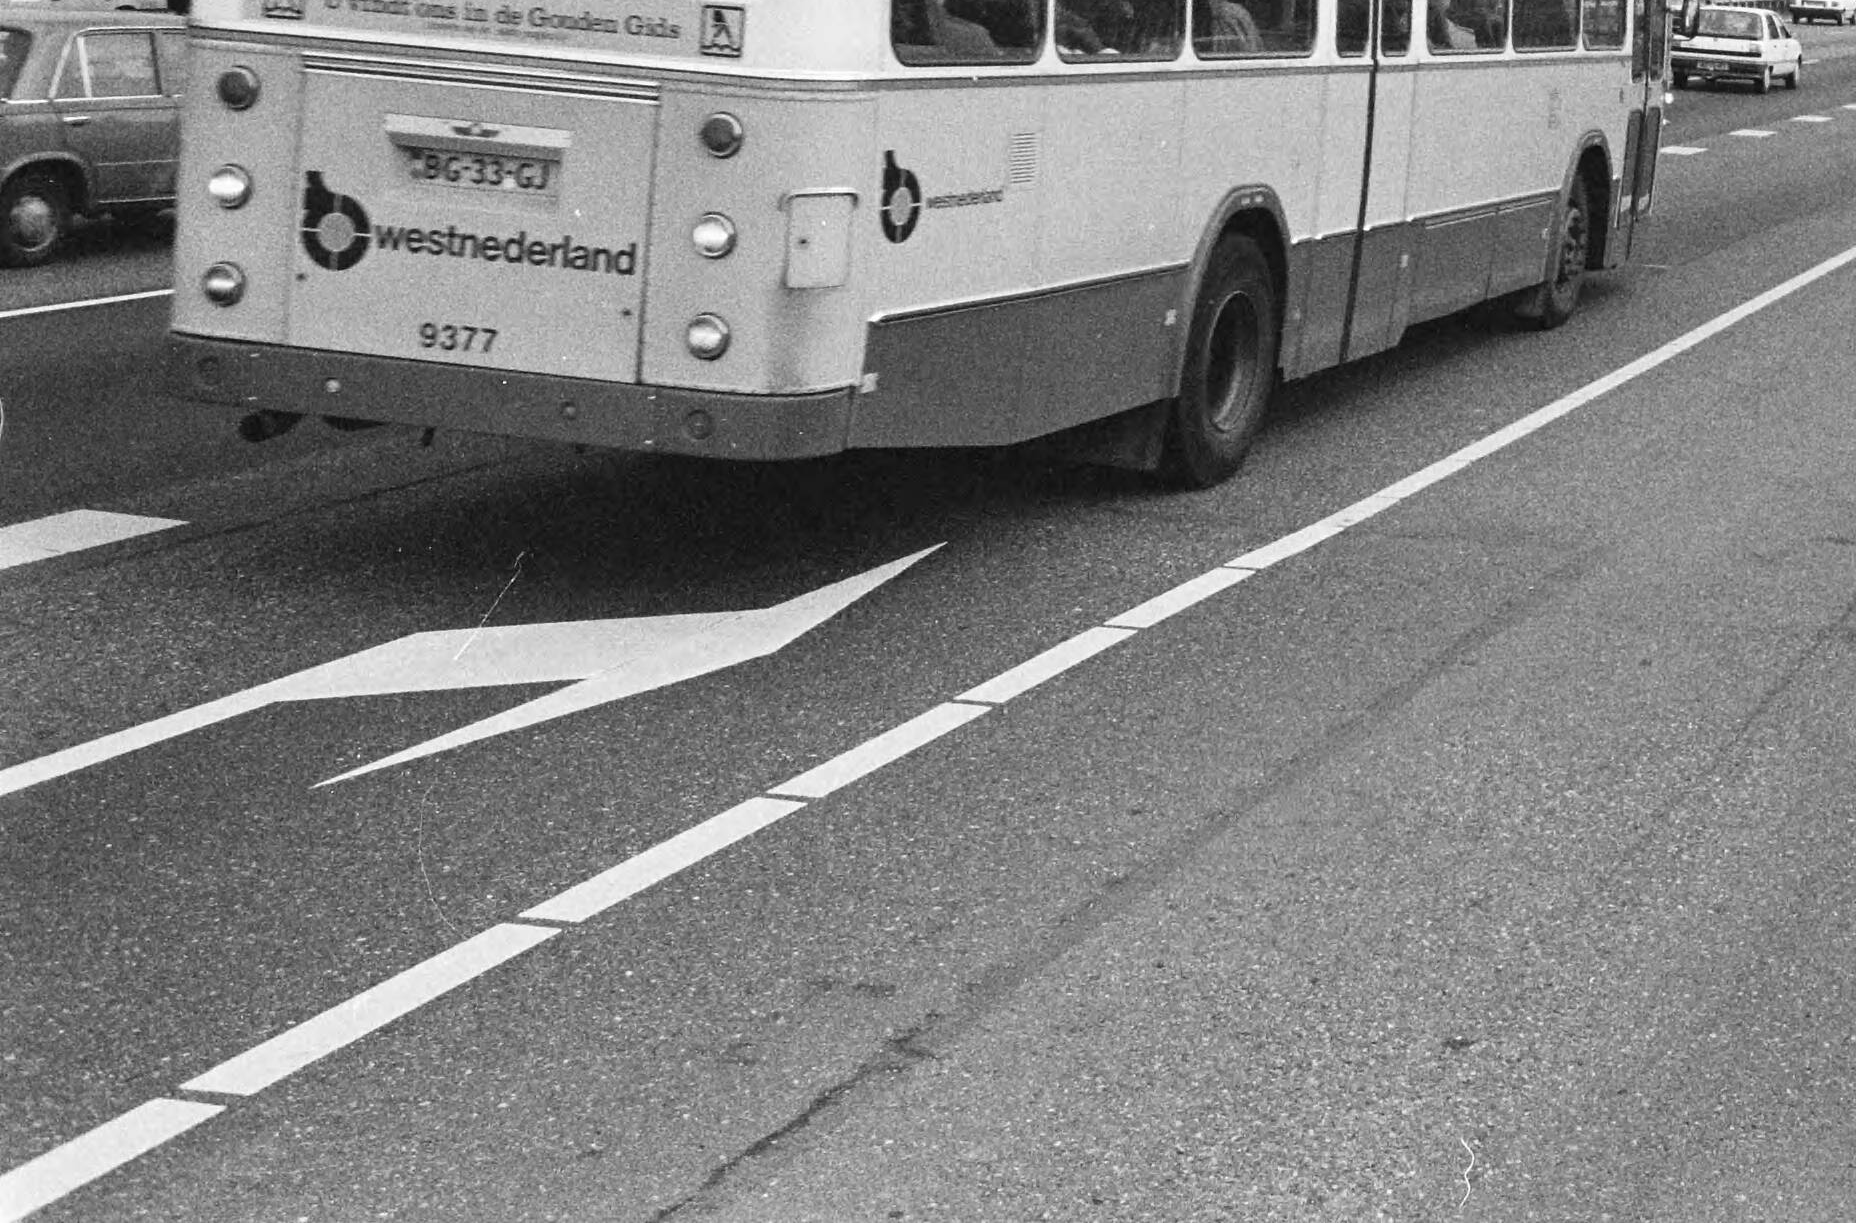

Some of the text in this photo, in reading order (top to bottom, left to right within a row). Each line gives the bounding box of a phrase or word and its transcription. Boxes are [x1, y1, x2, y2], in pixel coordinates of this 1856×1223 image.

[494, 5, 523, 26] de
[527, 7, 619, 34] Gouden
[624, 15, 682, 39] Gids
[374, 224, 638, 276] westnederland
[419, 321, 499, 354] 9377
